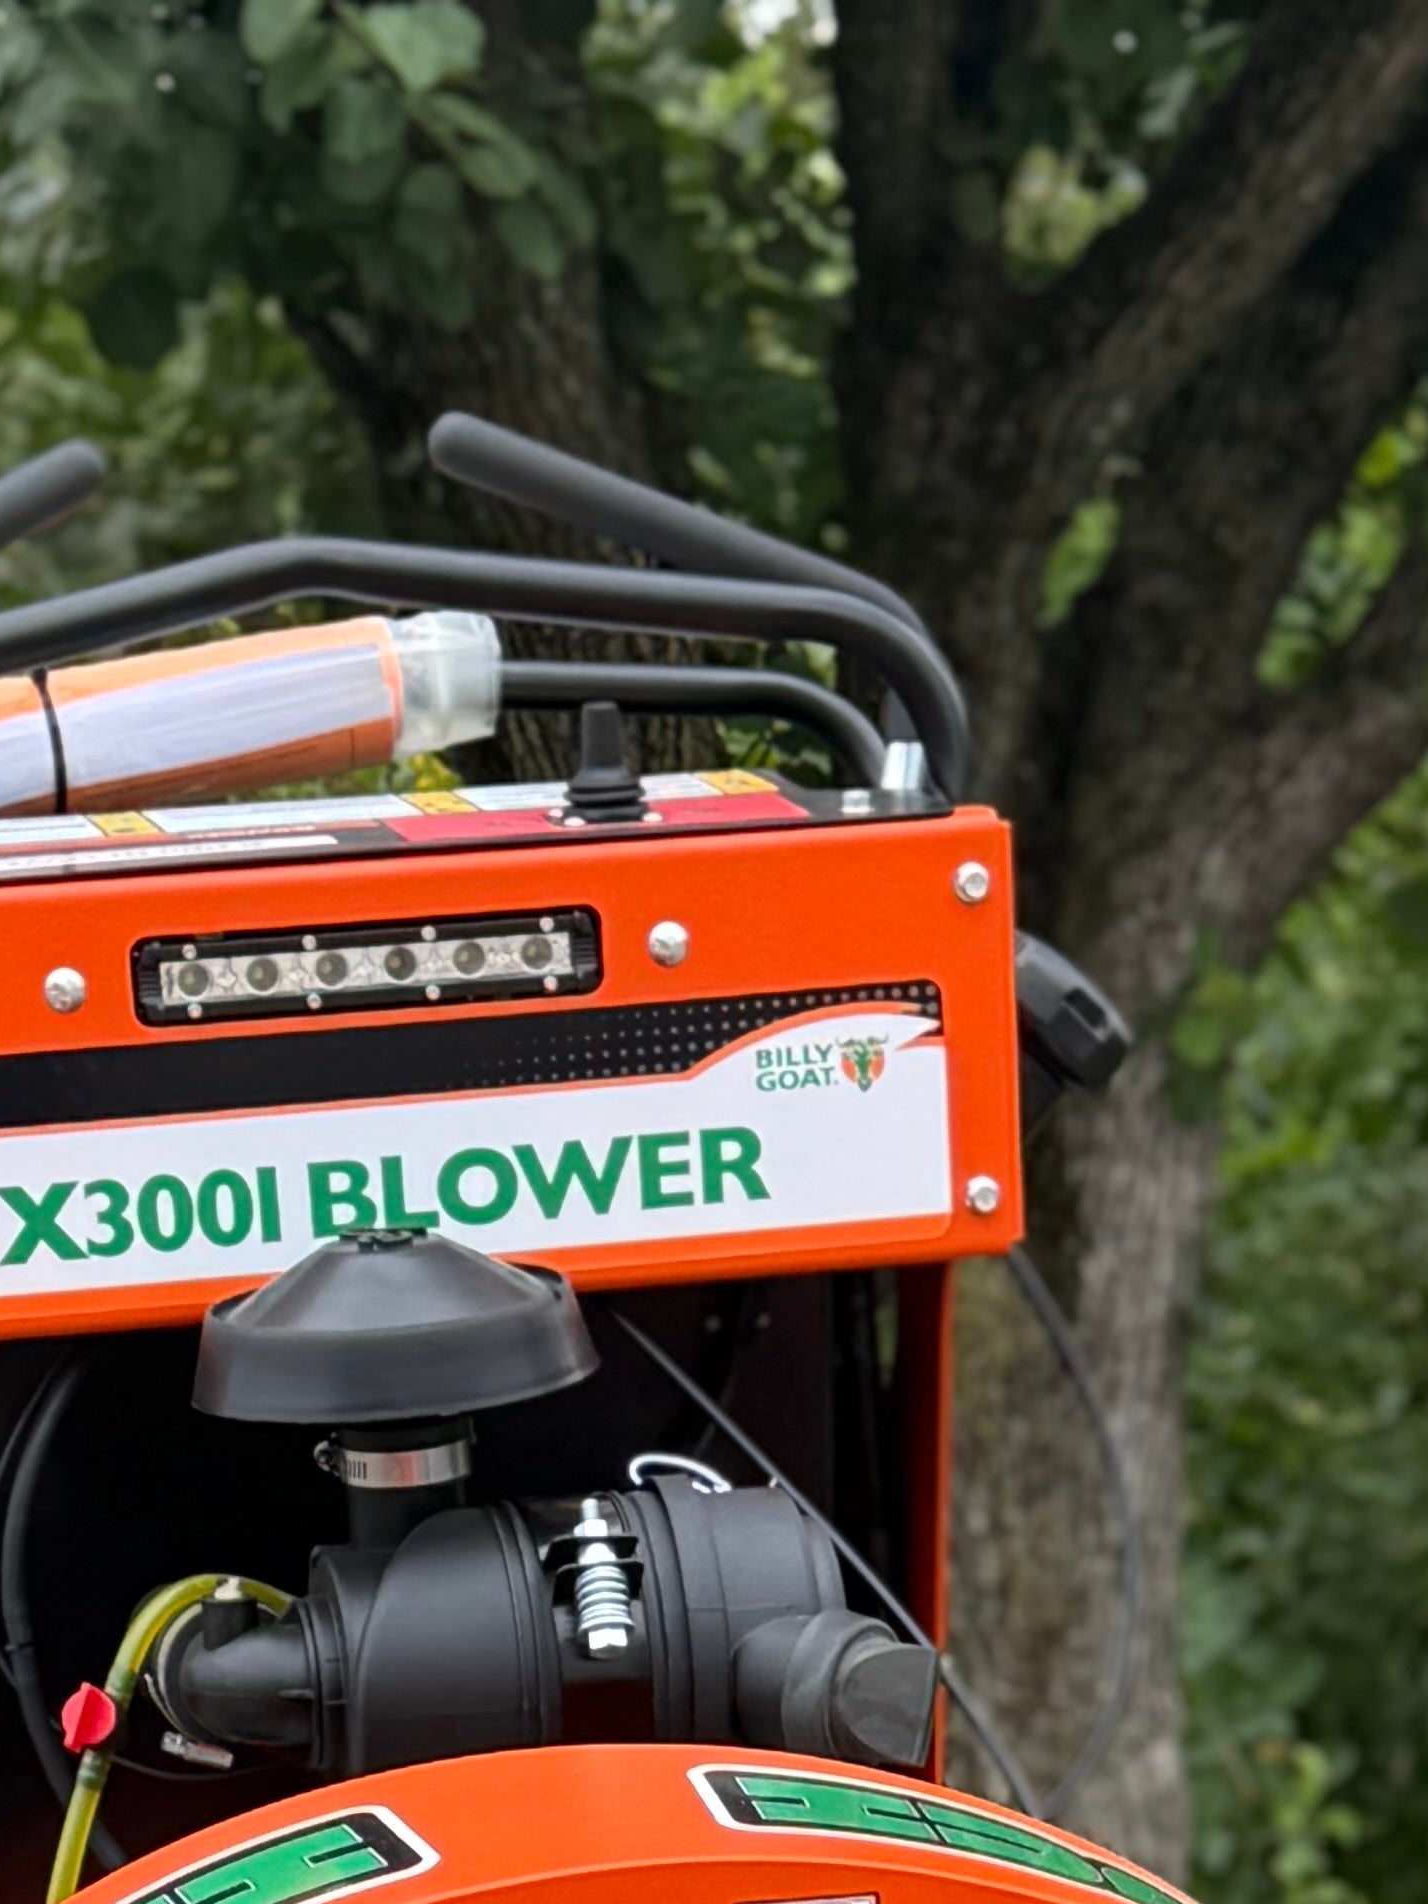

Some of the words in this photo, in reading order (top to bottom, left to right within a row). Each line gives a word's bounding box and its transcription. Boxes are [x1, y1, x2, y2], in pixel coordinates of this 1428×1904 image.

[755, 1043, 832, 1068] BILLY
[755, 1067, 836, 1092] GOAT
[307, 1126, 772, 1238] BLOWER
